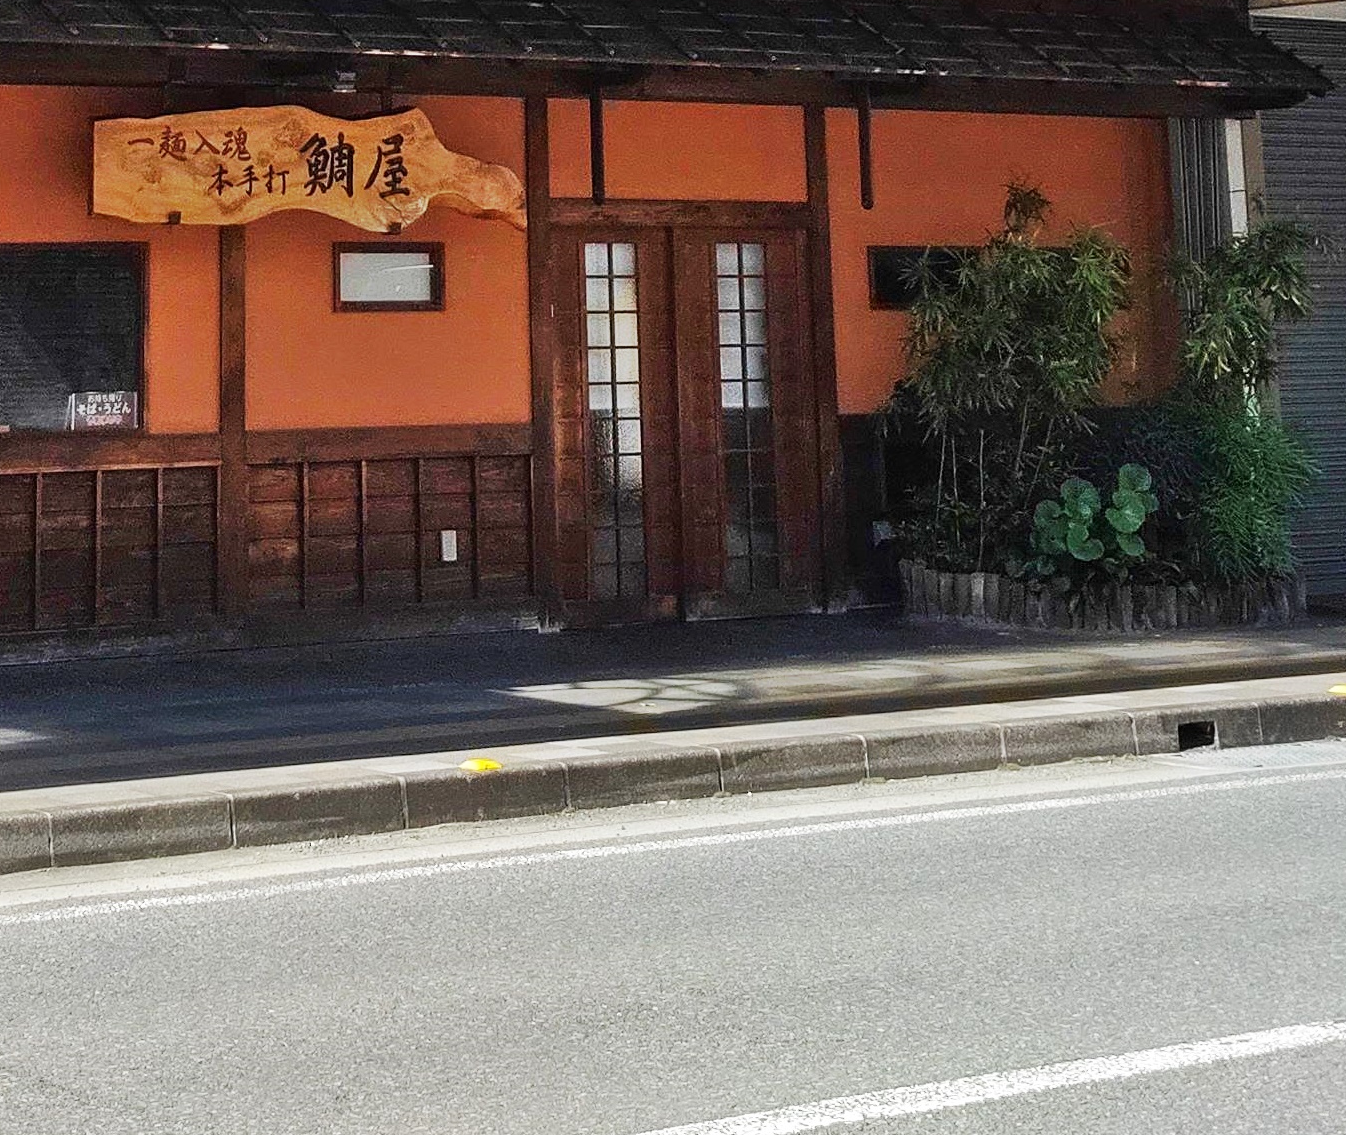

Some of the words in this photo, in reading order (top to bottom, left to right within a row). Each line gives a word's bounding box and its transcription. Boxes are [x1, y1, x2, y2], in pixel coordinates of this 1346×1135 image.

[206, 165, 290, 197] 本手打
[299, 132, 411, 199] 鯛屋
[77, 402, 132, 415] そば・うどん
